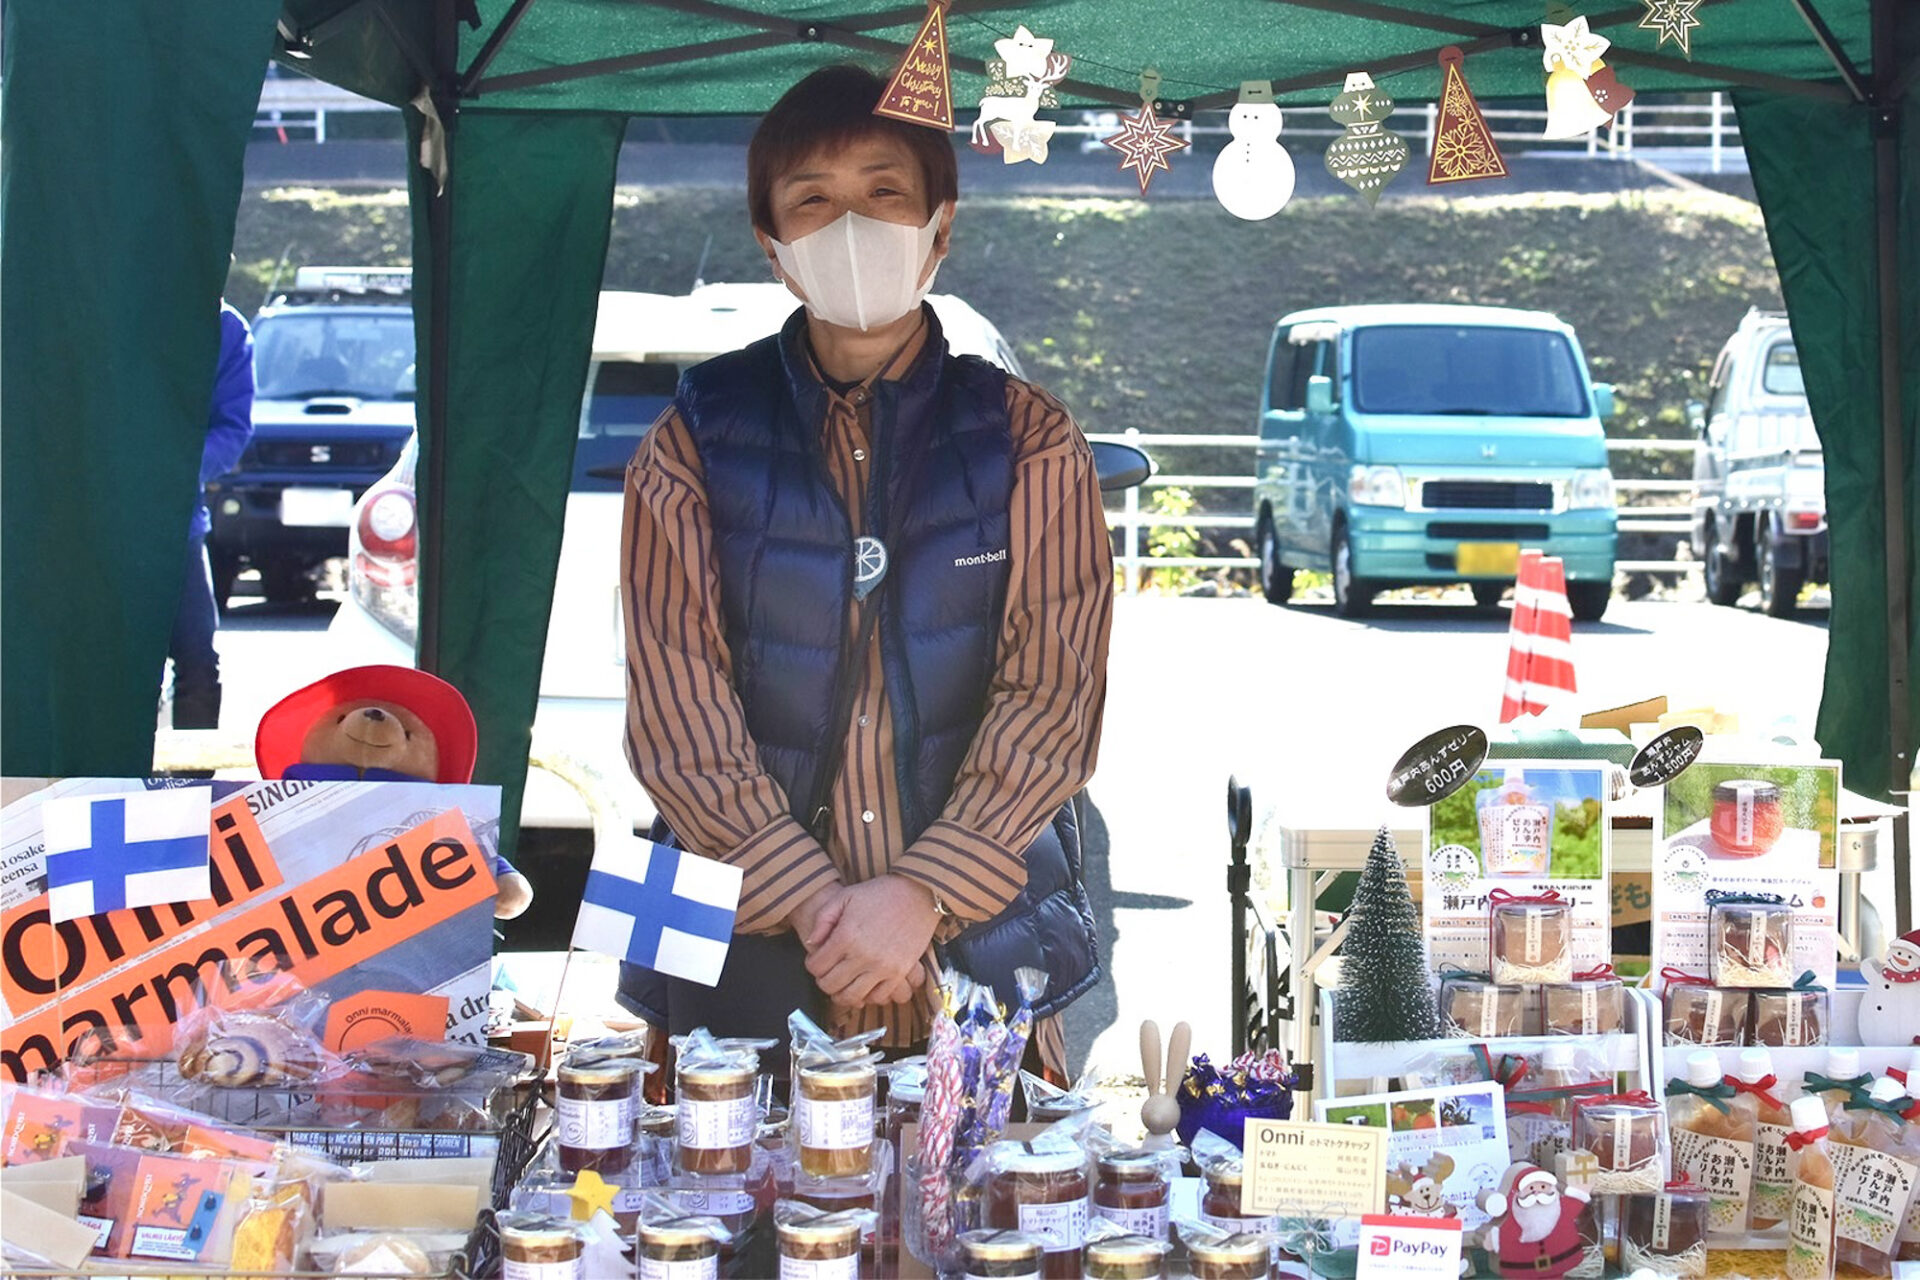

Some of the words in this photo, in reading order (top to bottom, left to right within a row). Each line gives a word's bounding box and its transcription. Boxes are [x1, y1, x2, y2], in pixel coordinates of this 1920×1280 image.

[1425, 758, 1468, 793] 600円
[9, 843, 46, 865] osake
[0, 862, 39, 885] eensa
[345, 1007, 369, 1024] Onni
[1260, 1128, 1304, 1145] Onni
[1393, 1239, 1448, 1258] PayPay
